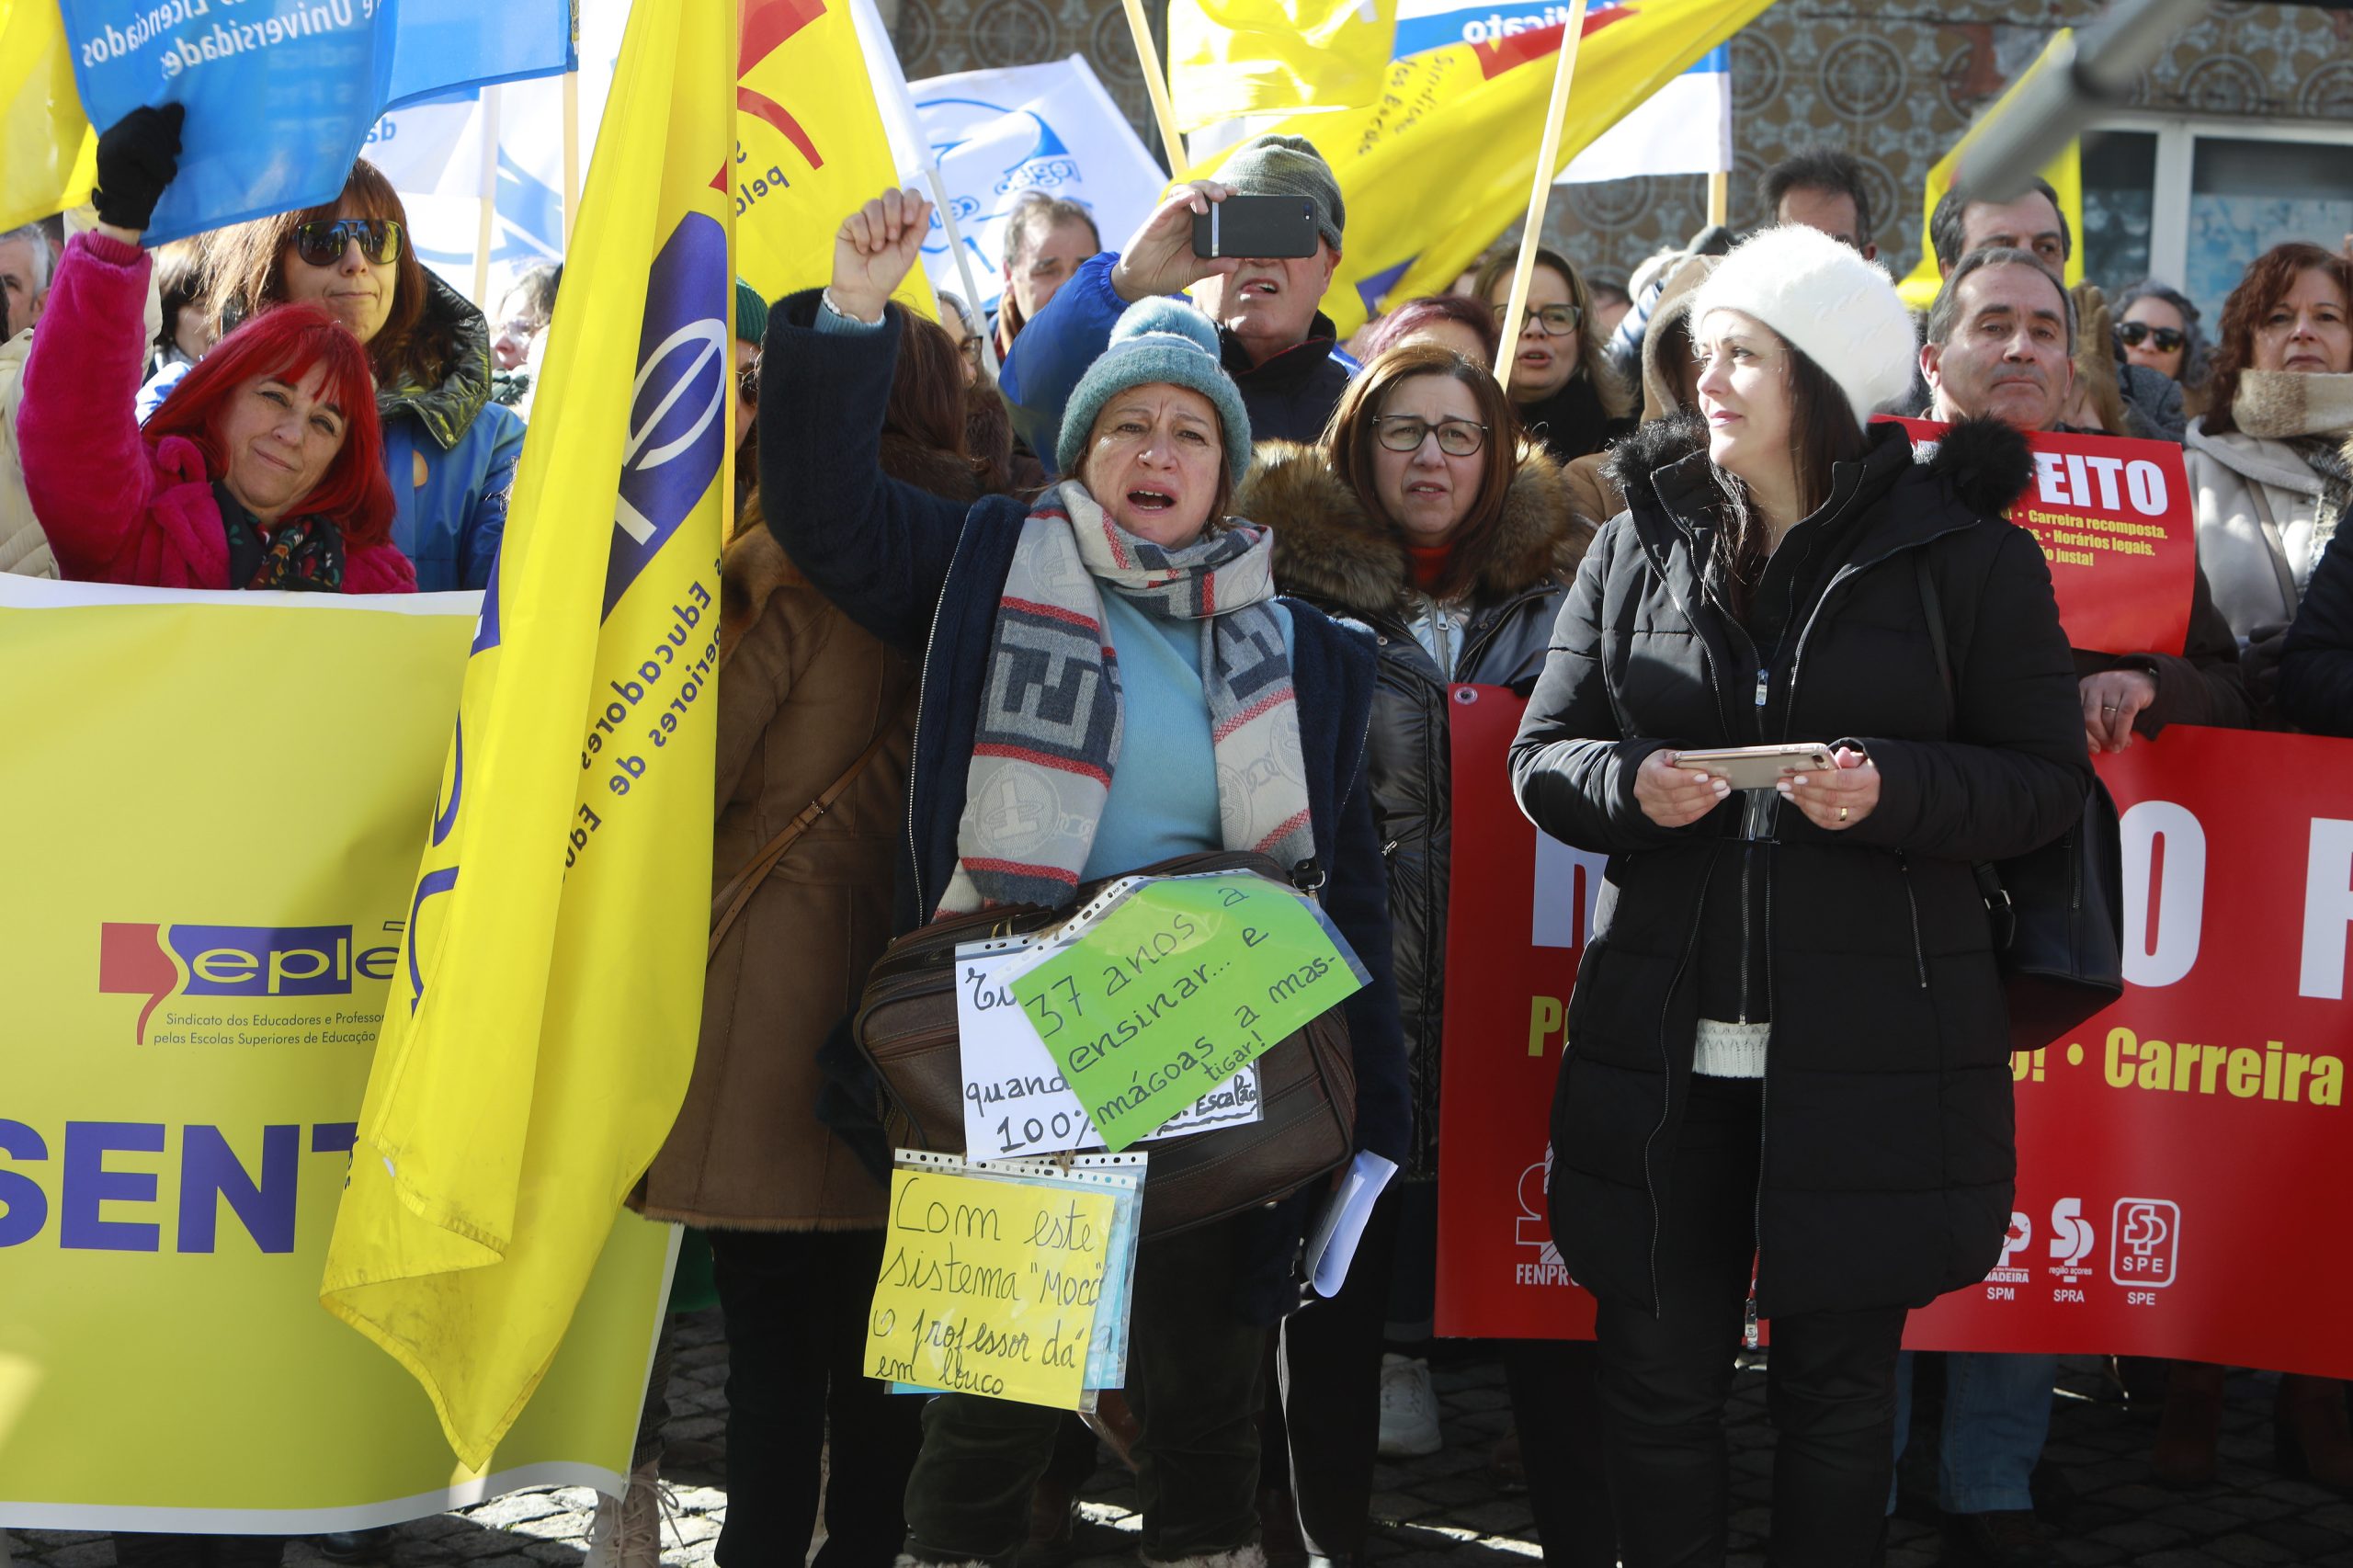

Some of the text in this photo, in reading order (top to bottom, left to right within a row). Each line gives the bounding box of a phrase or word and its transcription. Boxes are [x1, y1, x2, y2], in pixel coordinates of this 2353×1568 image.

[2028, 509, 2085, 529] Carreira
[2086, 517, 2168, 540] recomposta.
[2053, 529, 2110, 551] Horários
[2112, 537, 2156, 557] legais.
[2056, 549, 2094, 567] justa!
[1025, 887, 1250, 1038] 37 anos a
[1068, 926, 1269, 1073] ensinar... e
[166, 1013, 222, 1026] Sindicato
[227, 1014, 248, 1027] dos
[253, 1014, 321, 1027] Educadores
[324, 1017, 332, 1025] e
[153, 1030, 376, 1047] pelas Escolas Superiores de Educação
[1097, 957, 1336, 1126] mágoas a mas-
[1200, 1029, 1266, 1082] tigar!
[2104, 1026, 2344, 1107] Carreira
[896, 1177, 1001, 1242] Com
[1023, 1199, 1096, 1253] este
[878, 1242, 1021, 1301] sistema
[1516, 1263, 1580, 1287] FENPR
[1987, 1287, 2015, 1301] SPM
[2053, 1290, 2086, 1302] SPRA
[2127, 1291, 2156, 1305] SPE
[911, 1309, 1033, 1366] professor
[1041, 1319, 1086, 1369] dá
[875, 1355, 917, 1382] em
